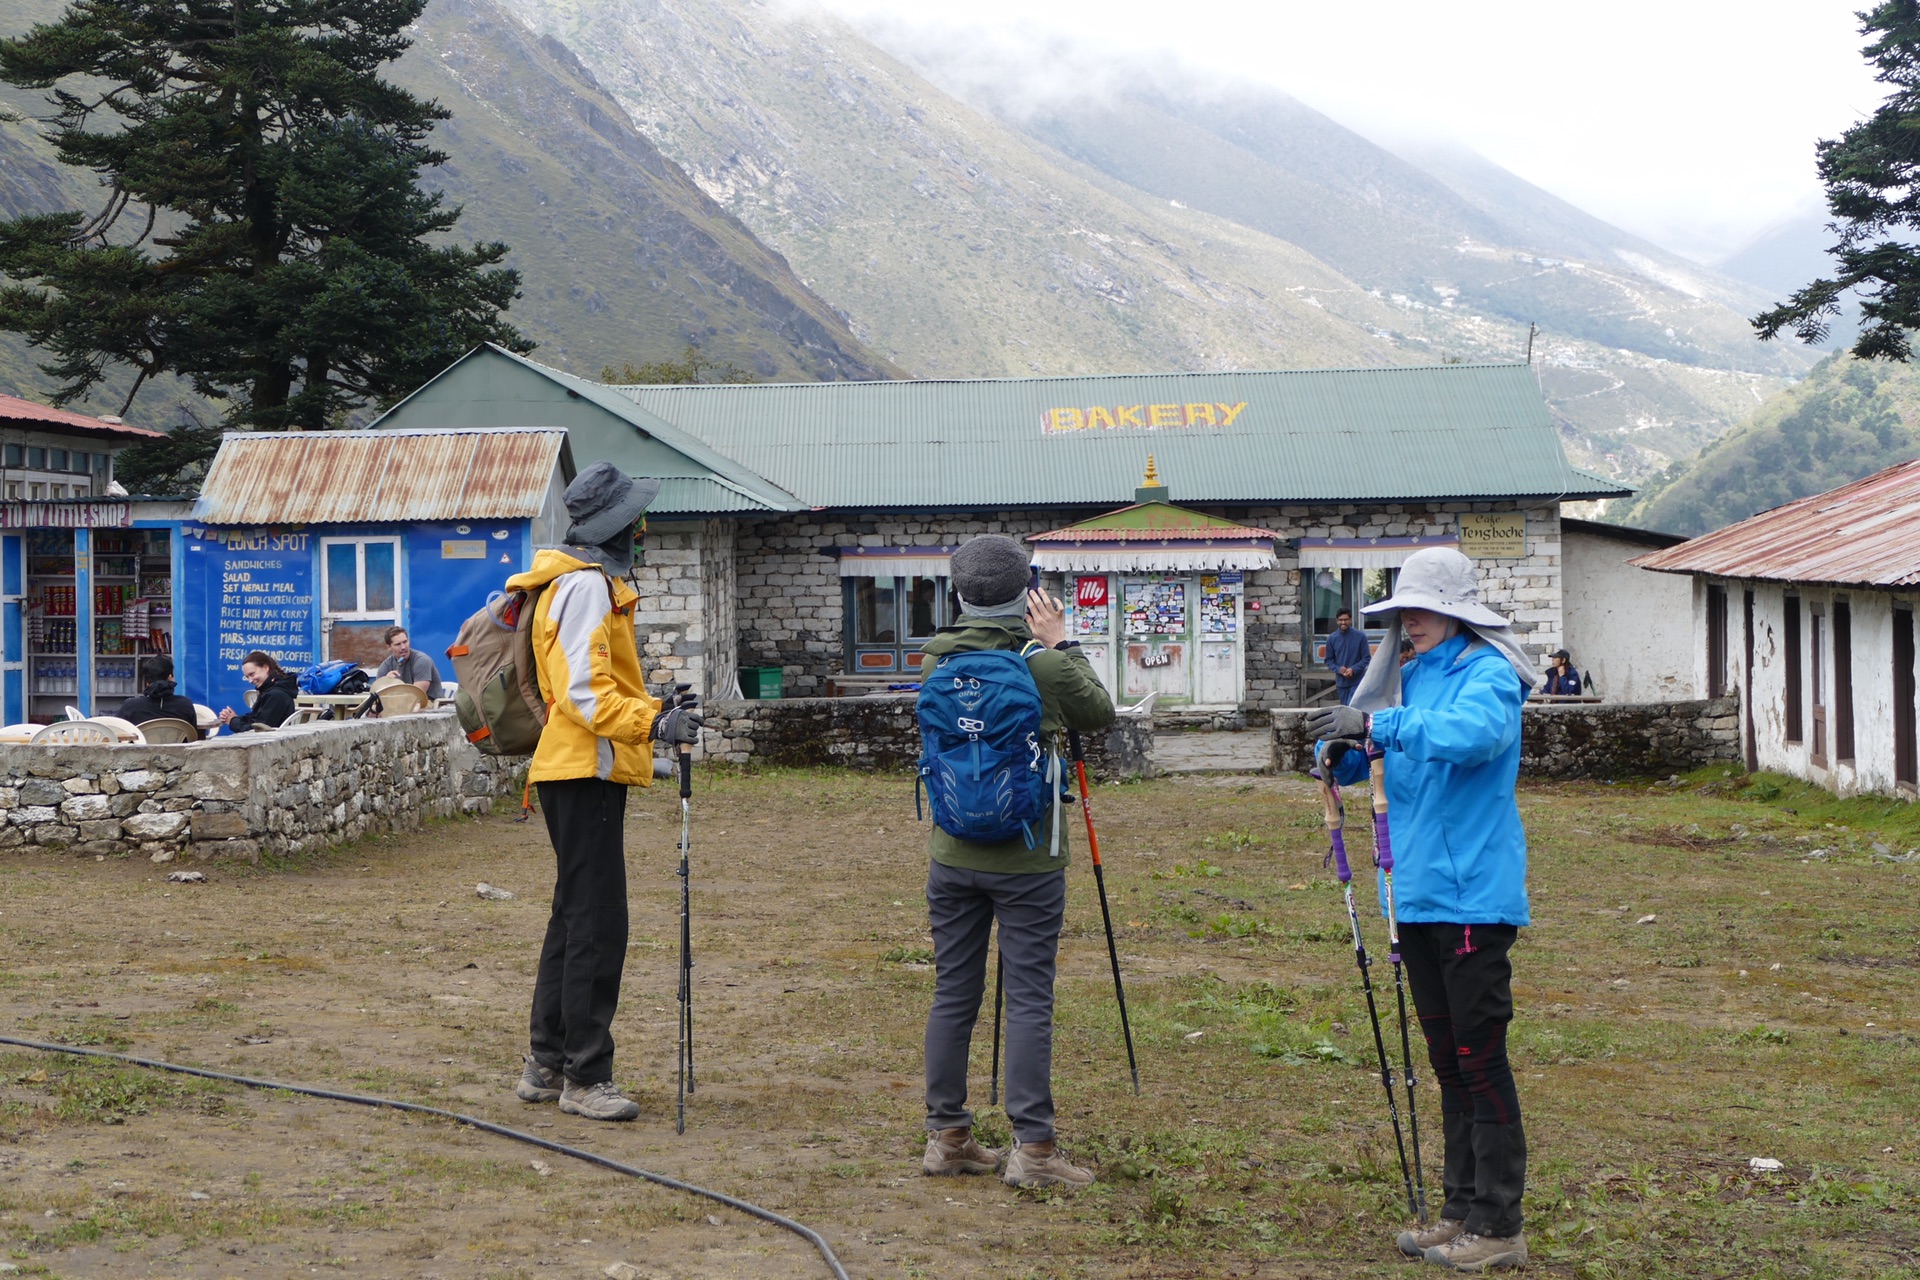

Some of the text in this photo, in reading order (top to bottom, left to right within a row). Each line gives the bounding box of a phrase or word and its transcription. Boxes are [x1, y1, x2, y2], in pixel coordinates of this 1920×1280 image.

[1042, 402, 1248, 433] BAKERY
[6, 504, 22, 528] TO
[26, 504, 46, 528] MY
[48, 504, 88, 528] LITTLE
[90, 504, 126, 528] SHOP
[1461, 526, 1524, 540] Tengboche
[272, 534, 309, 550] SPOT
[225, 560, 282, 570] SANDWICHES
[223, 572, 250, 582] SALAD
[223, 583, 295, 592] SET NEPALI MEAL
[1080, 581, 1104, 603] illy
[223, 595, 312, 604] RICE WITH CHICKEN CURRY
[222, 607, 308, 618] RICE WITH YAK CURRY
[264, 621, 287, 631] APPLE
[290, 622, 303, 631] PIE
[220, 633, 303, 646] MARS, SNICKERS PIE
[220, 648, 247, 659] FRESH
[285, 651, 313, 662] COFFEE
[1145, 654, 1168, 666] OPEN
